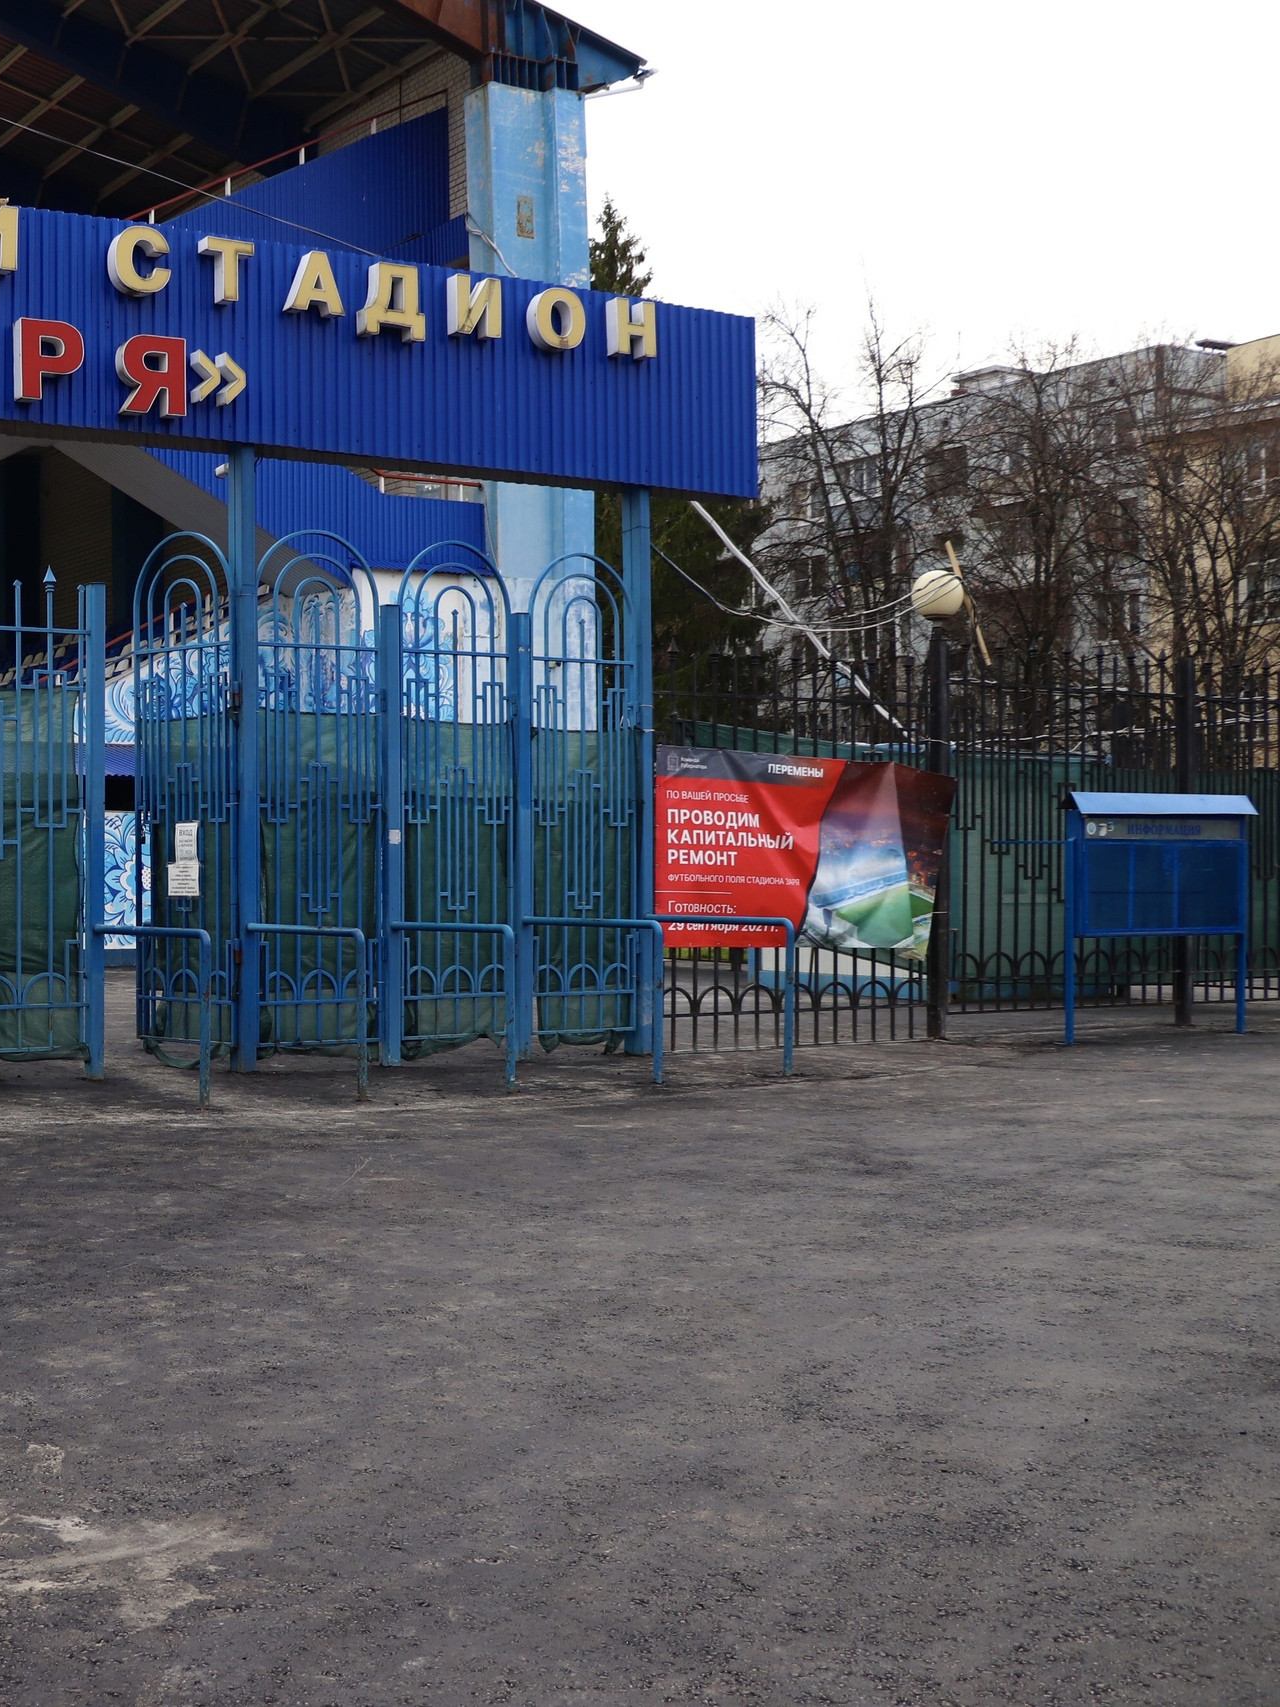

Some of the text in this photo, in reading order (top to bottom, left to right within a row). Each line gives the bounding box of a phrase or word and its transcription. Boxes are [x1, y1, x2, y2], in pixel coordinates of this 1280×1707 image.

[107, 225, 658, 361] СТАДИОН
[767, 763, 825, 778] ПЕРЕМЕНЫ
[666, 789, 750, 804] ПО ВАШЕЙ ПРОСЬБЕ
[667, 808, 760, 830] ПРОВОДИМ
[1127, 823, 1202, 836] ИНФОРМАЦИЯ
[667, 829, 794, 850] КАПИТАЛЬНЫЙ
[667, 849, 738, 867] РЕМОНТ
[667, 873, 801, 886] ФУТБОЛЬНОГО ПОЛЯ СТАДИОНА ЗАРЯ
[667, 900, 737, 914] Готовность:
